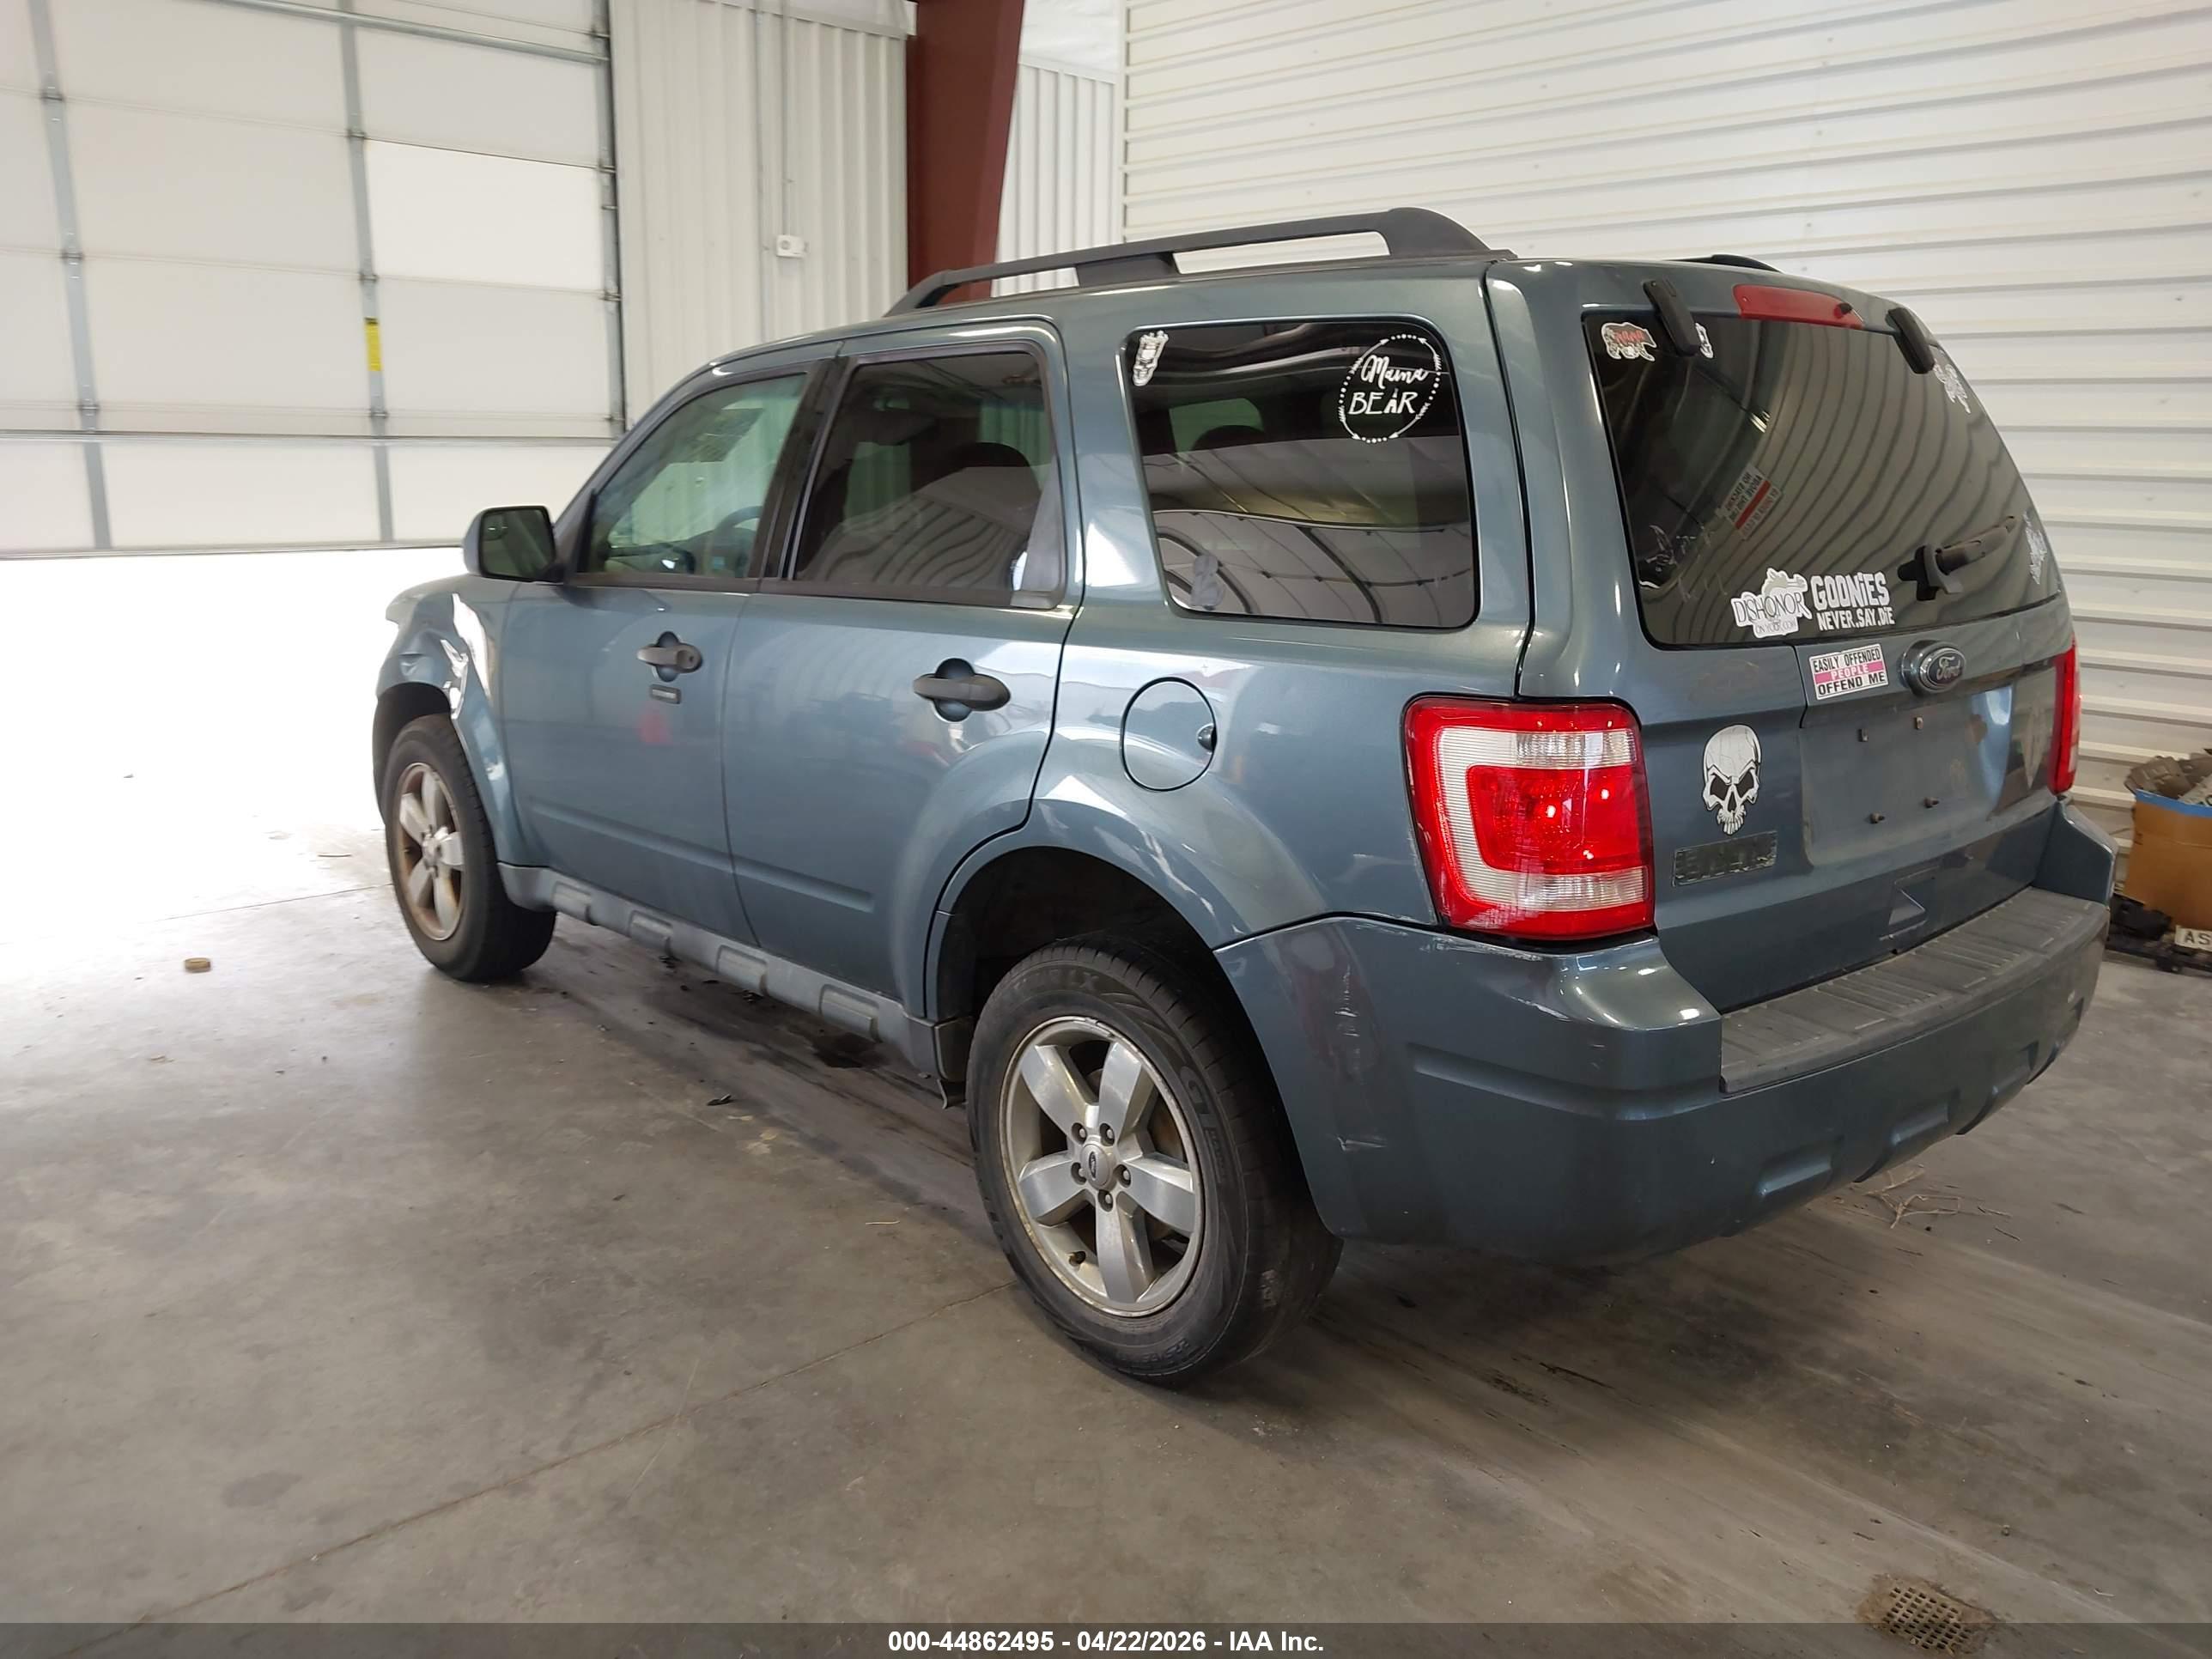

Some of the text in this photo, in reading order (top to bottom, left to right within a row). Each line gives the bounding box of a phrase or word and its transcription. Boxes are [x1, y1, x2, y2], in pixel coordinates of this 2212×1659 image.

[1360, 355, 1429, 389] Mama
[1348, 388, 1418, 415] BEAR
[1734, 592, 1810, 623] DISHONOR
[1813, 647, 1881, 673] EASILY OFFENDED
[1830, 664, 1869, 681] PEOPLE
[1818, 672, 1886, 696] OFFEND ME
